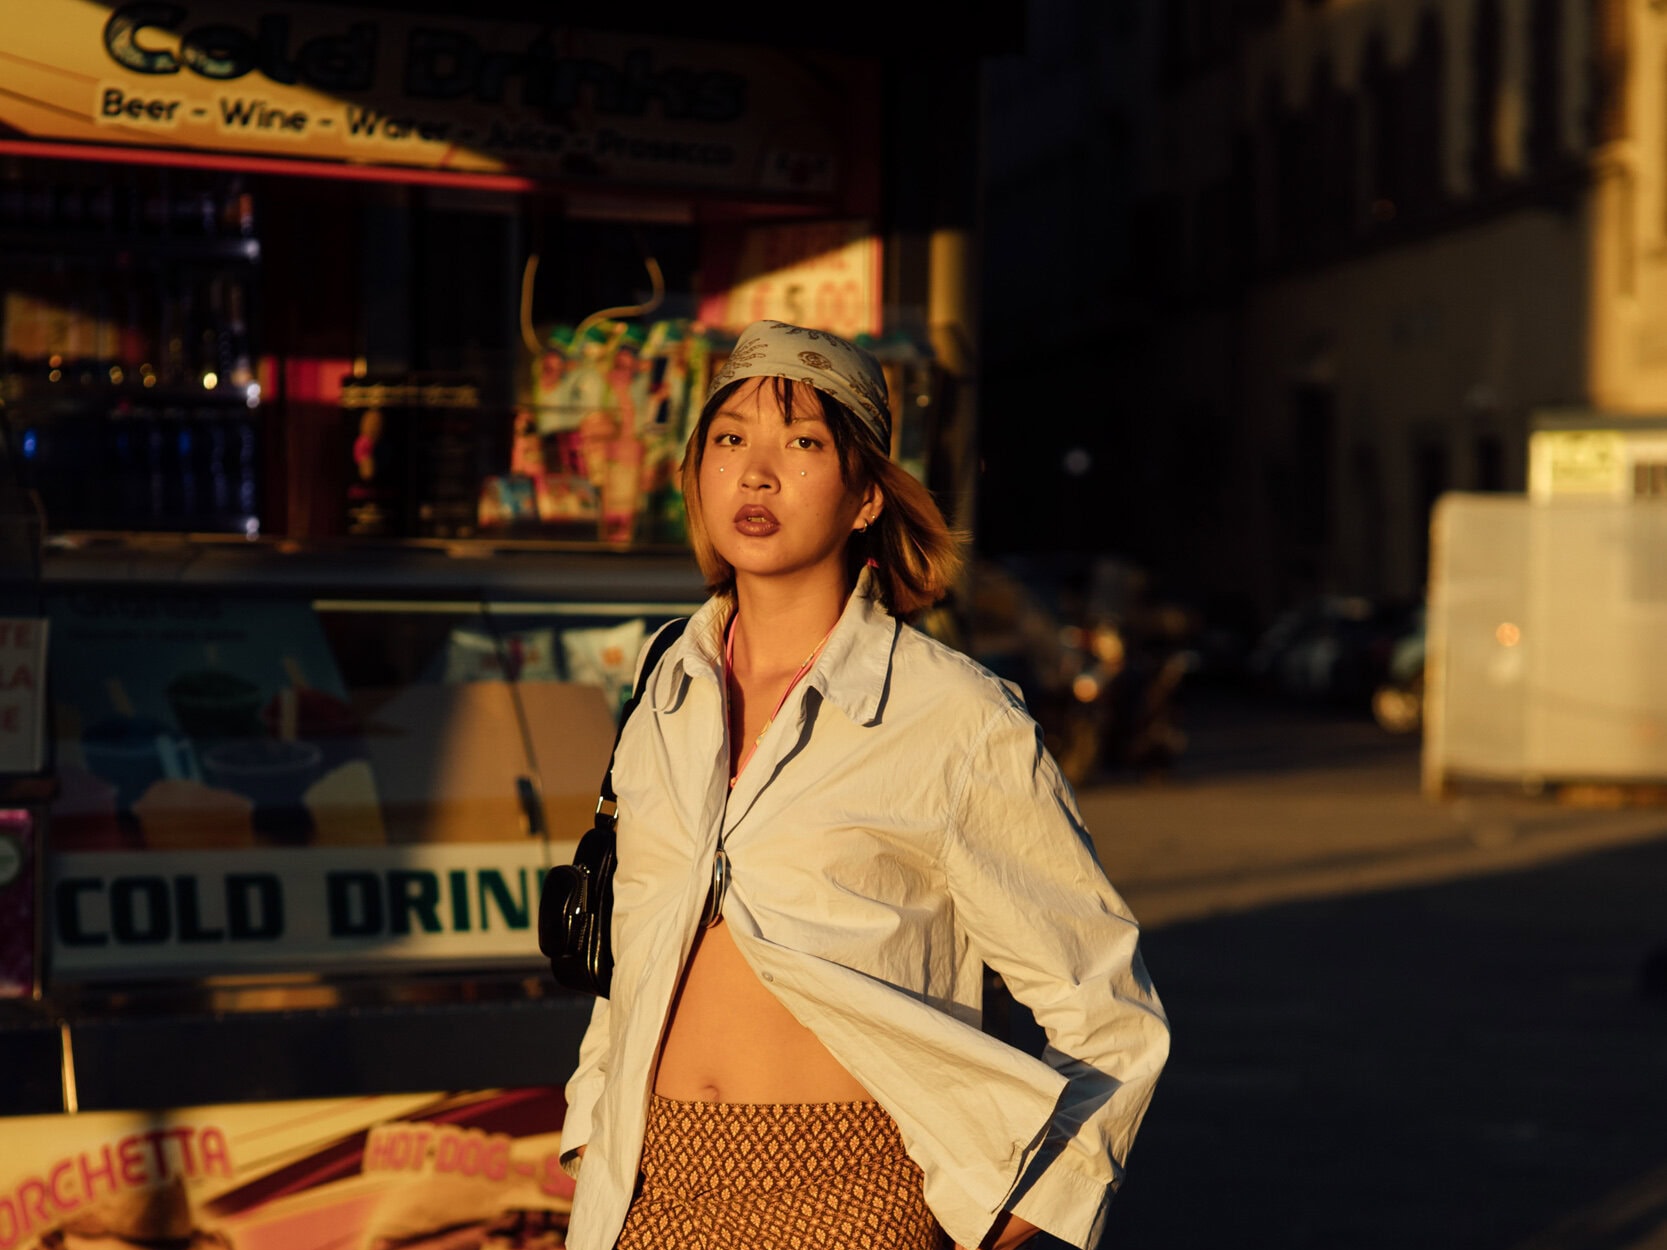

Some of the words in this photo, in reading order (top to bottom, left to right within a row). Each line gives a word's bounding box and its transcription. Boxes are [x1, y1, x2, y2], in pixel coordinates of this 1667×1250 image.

[104, 2, 376, 91] Cold
[406, 30, 746, 122] Drinks
[102, 88, 178, 118] Beer
[219, 99, 307, 131] Wine
[488, 122, 562, 153] Juice
[597, 127, 734, 167] Prosecco
[55, 872, 285, 947] COLD
